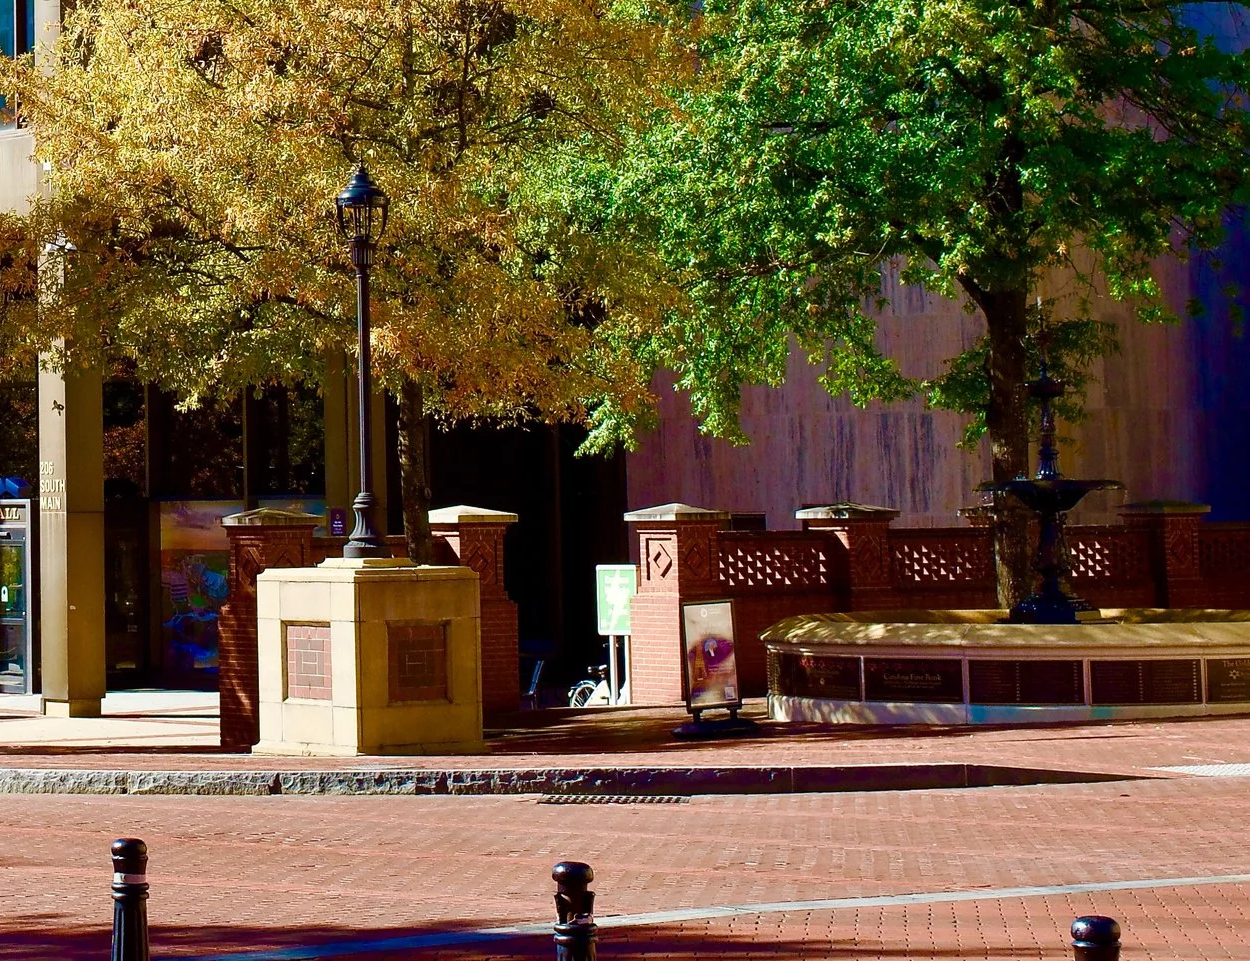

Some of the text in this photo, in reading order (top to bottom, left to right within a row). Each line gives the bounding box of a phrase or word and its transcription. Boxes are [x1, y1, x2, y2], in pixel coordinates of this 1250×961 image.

[40, 461, 54, 475] 206
[40, 479, 66, 493] SOUTH
[40, 496, 62, 510] MAIN
